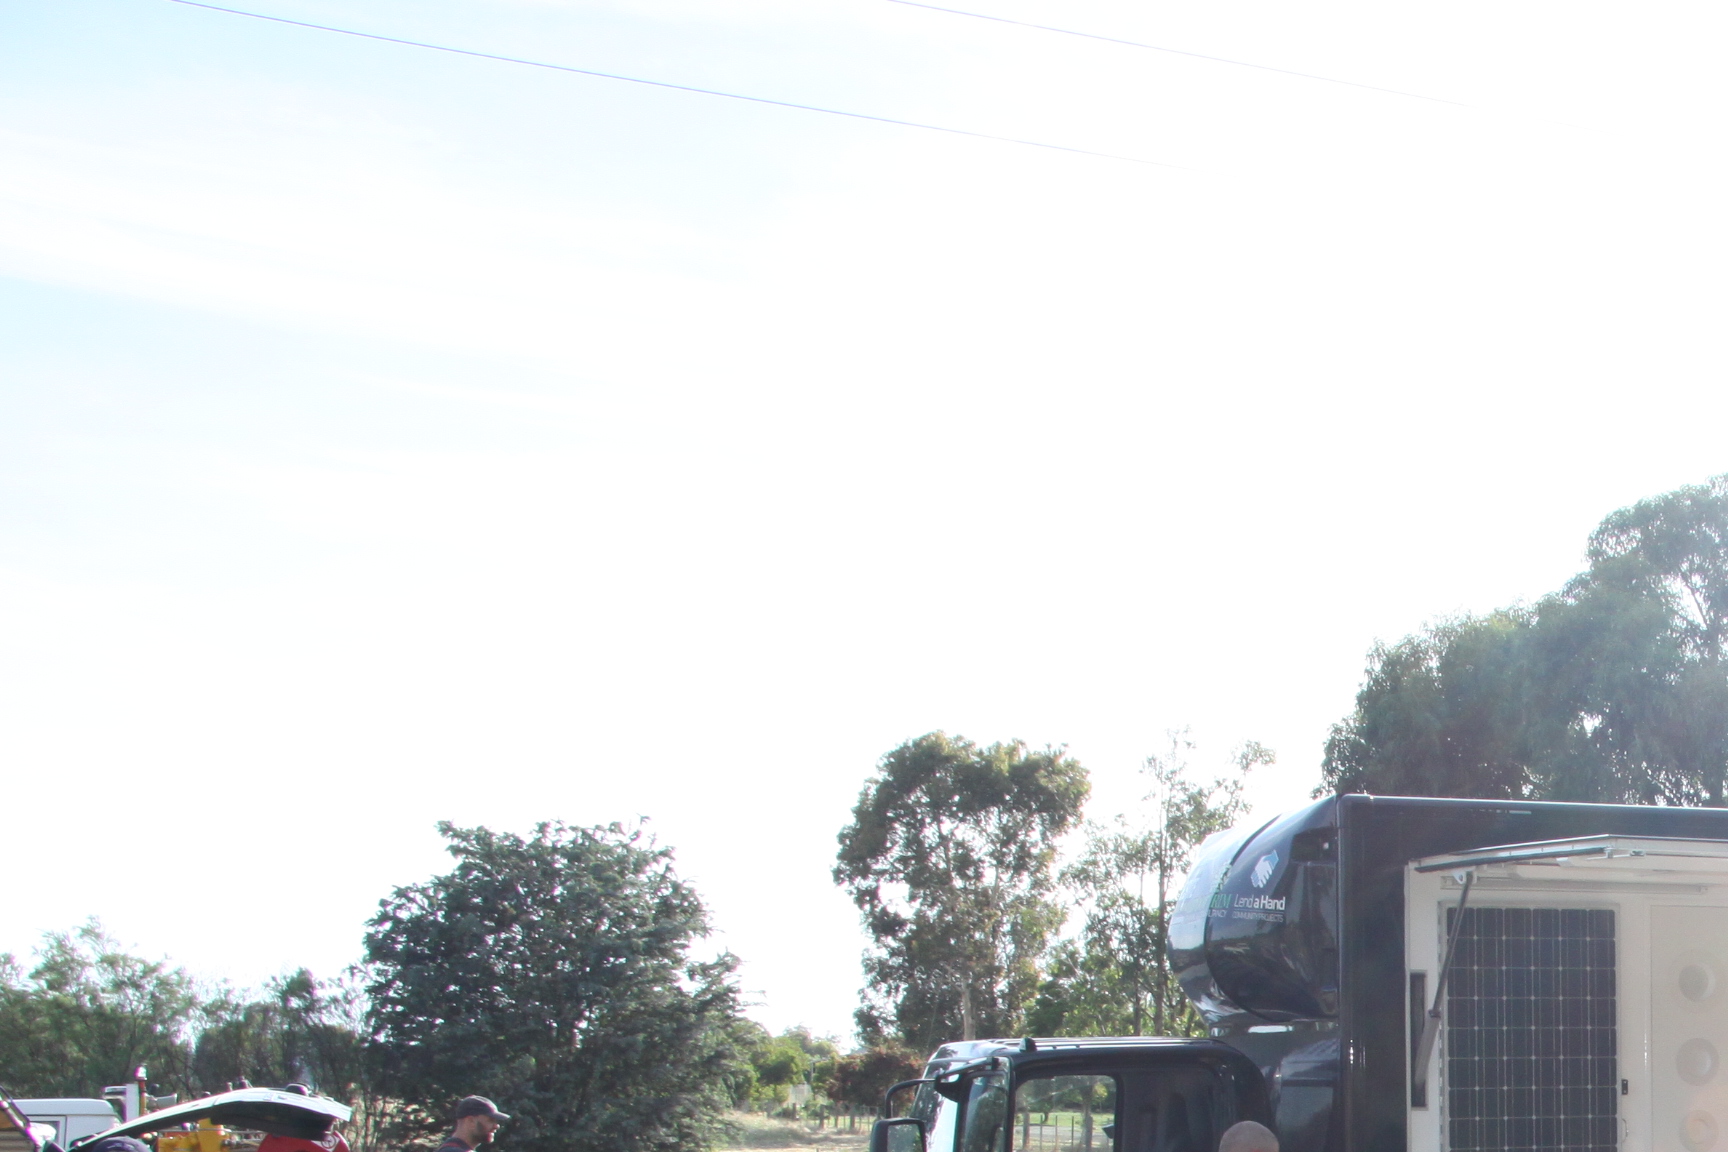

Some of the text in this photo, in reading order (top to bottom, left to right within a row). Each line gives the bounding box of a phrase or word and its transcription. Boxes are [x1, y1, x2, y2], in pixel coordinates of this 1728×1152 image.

[1234, 894, 1286, 910] Lend a Hand
